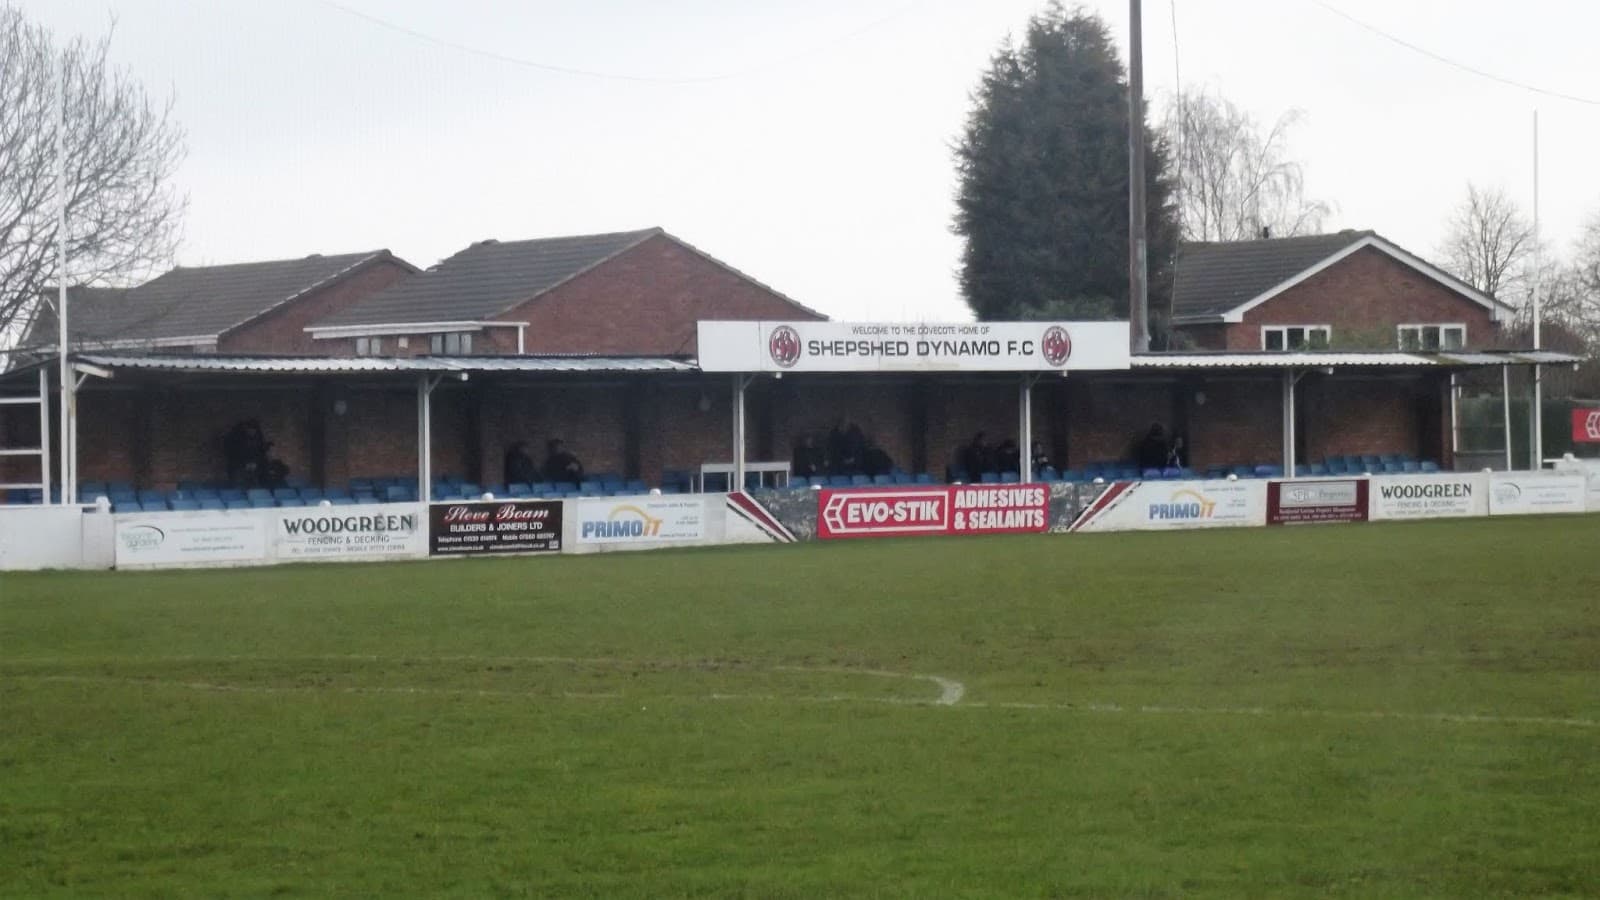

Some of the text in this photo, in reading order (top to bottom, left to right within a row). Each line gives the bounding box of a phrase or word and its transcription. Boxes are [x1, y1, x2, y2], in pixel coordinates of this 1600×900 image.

[852, 325, 990, 335] WELCOME TO THE DOVECOTE HOME OF
[808, 340, 909, 356] SHEPSHED
[917, 340, 1000, 356] DYNAMO
[954, 488, 1044, 508] ADHESIVES
[1381, 484, 1472, 499] WOODGREEN
[444, 506, 490, 521] Steve
[954, 510, 1044, 530] & SEALANTS
[283, 515, 412, 534] WOODGREEN
[450, 521, 543, 533] BUILDERS & JOINERS LTD
[307, 537, 343, 545] FENCING
[354, 536, 390, 544] DECKING
